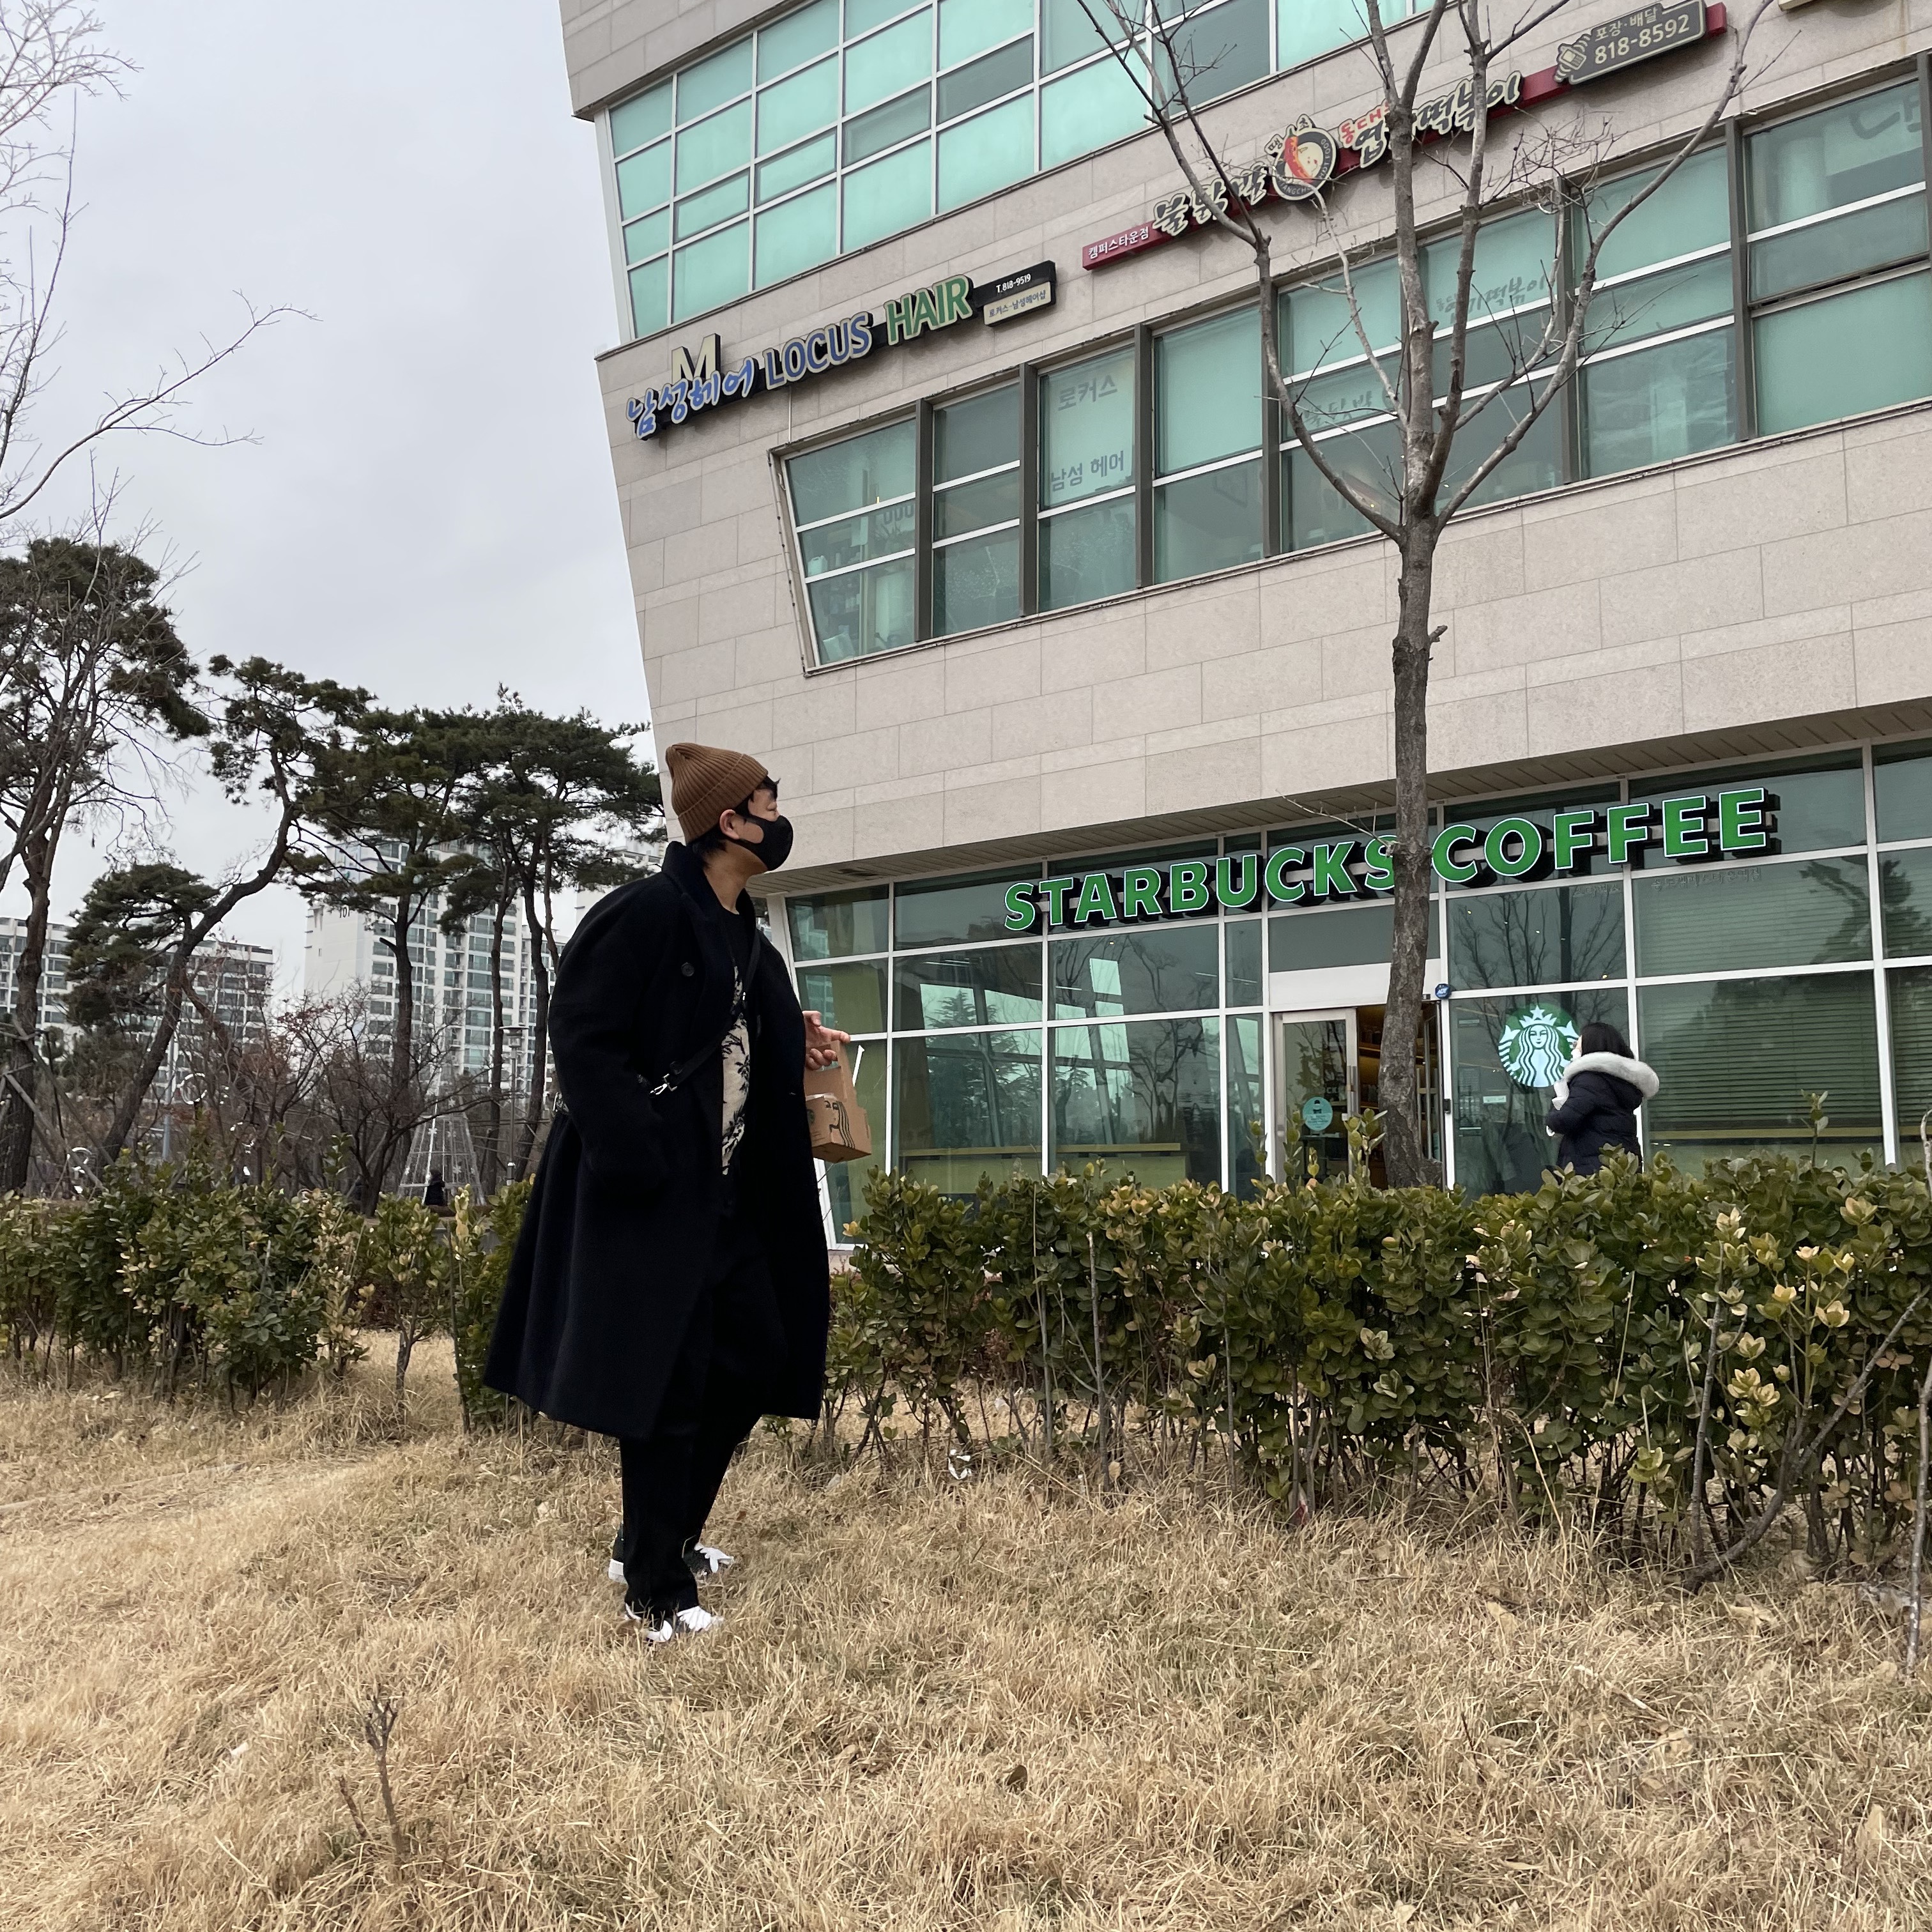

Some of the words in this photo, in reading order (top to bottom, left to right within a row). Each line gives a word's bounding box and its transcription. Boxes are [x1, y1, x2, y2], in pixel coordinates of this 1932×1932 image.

[1595, 14, 1690, 64] 818-8592
[1340, 101, 1390, 145] 동대
[1088, 226, 1149, 259] 캠퍼스타운점
[625, 356, 755, 440] 남성헤어
[763, 311, 872, 390] LOCUS
[884, 274, 973, 345] HAIR
[671, 333, 716, 384] M
[1058, 374, 1117, 411] 로커스
[1051, 463, 1082, 491] 남성
[1091, 450, 1123, 477] 헤어
[1004, 834, 1395, 931] STARBUCKS
[1431, 786, 1766, 883] COFFEE
